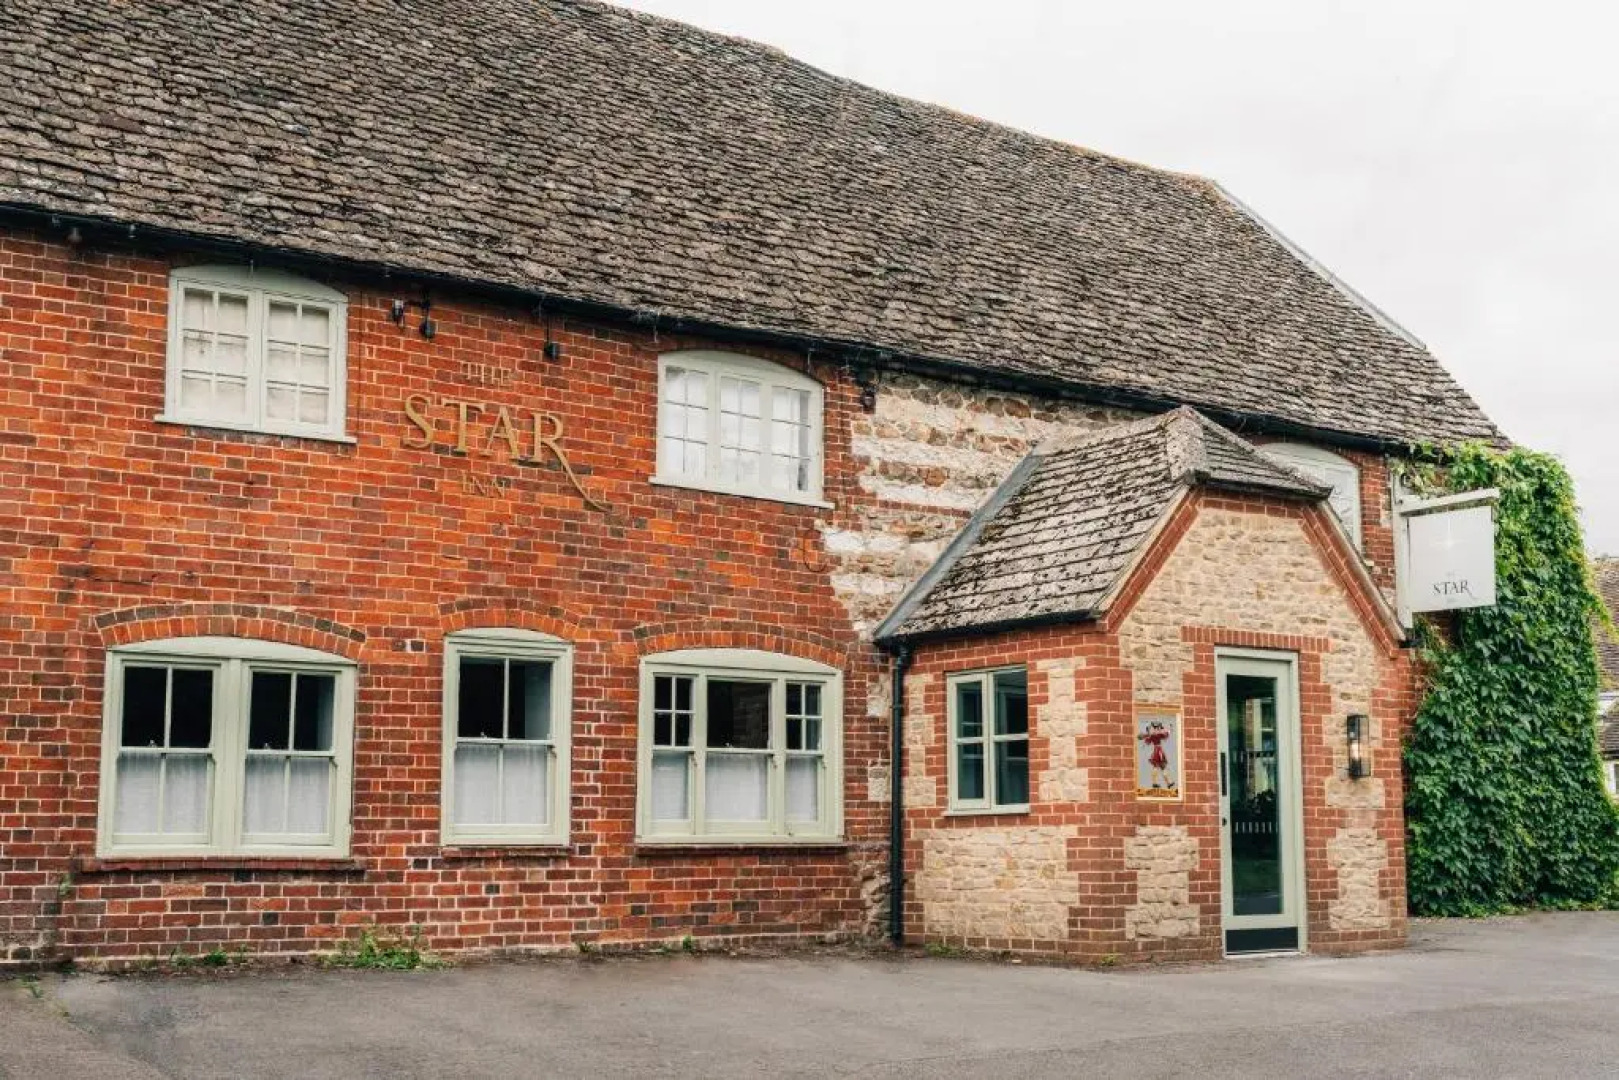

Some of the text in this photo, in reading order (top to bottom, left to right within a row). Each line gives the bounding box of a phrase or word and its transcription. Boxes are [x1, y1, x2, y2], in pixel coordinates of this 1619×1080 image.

[463, 362, 513, 386] THE
[402, 394, 612, 512] STAR
[462, 473, 507, 498] INN
[1433, 580, 1476, 598] STAR
